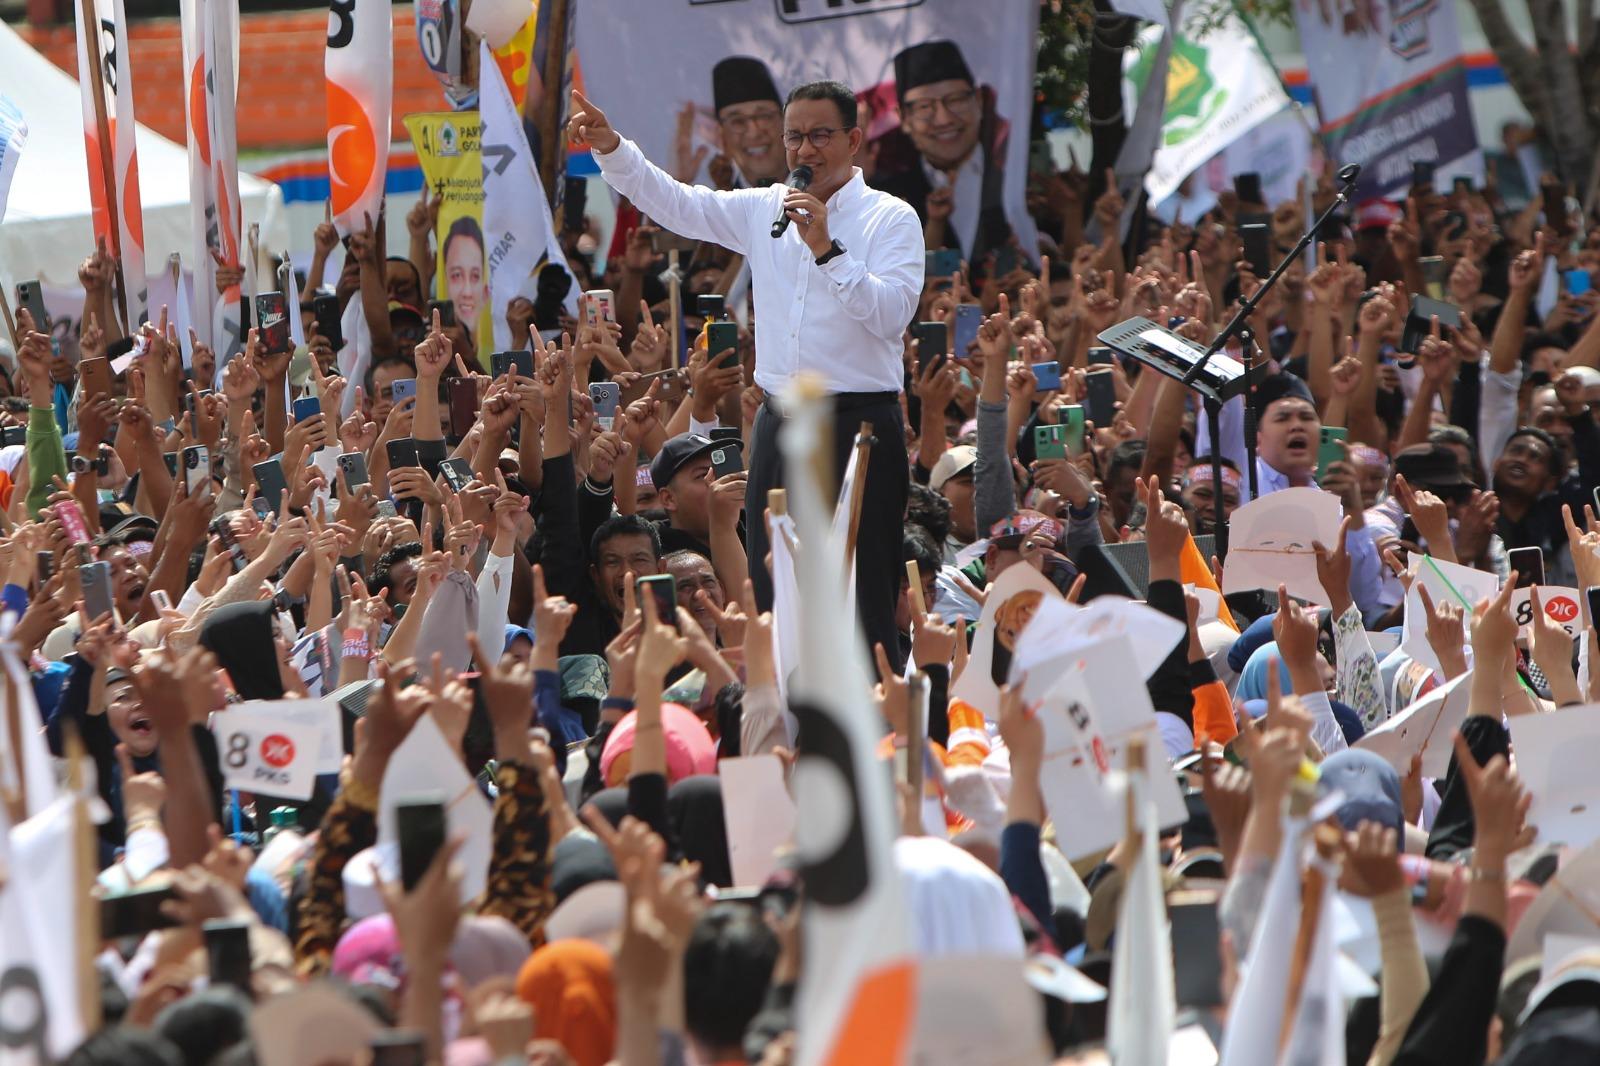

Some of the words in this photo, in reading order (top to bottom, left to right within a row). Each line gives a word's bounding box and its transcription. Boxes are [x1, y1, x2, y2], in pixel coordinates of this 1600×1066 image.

[265, 312, 282, 322] NIKE
[1516, 600, 1534, 626] 8
[226, 732, 249, 768] 8
